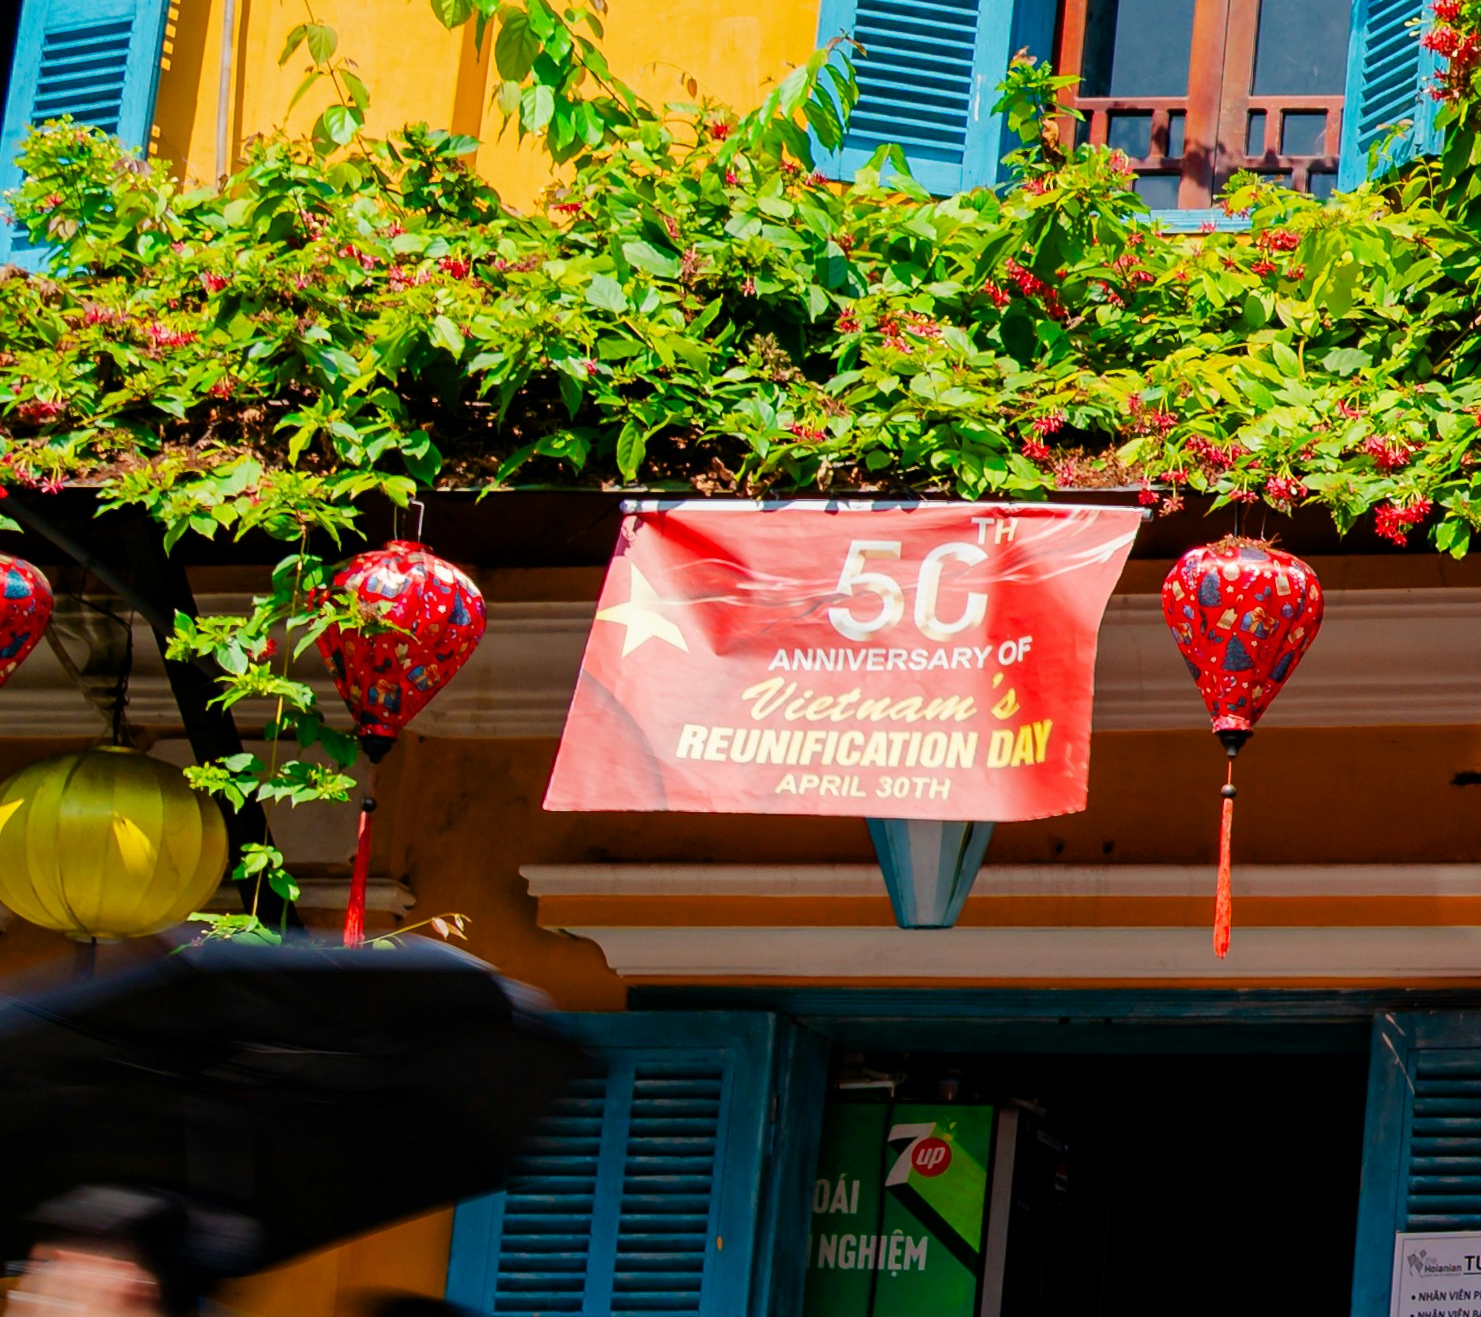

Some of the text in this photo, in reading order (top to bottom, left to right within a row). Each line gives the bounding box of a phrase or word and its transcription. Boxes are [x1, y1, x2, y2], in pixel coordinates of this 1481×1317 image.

[768, 636, 1033, 671] ANNIVERSARY OF
[676, 719, 1053, 769] REUNIFICATION DAY
[774, 773, 951, 800] APRIL 30TH
[812, 1173, 860, 1214] OÁI
[818, 1229, 928, 1277] NGHIỆM
[1418, 1290, 1446, 1301] NHÂN
[1450, 1289, 1471, 1301] VIÊN
